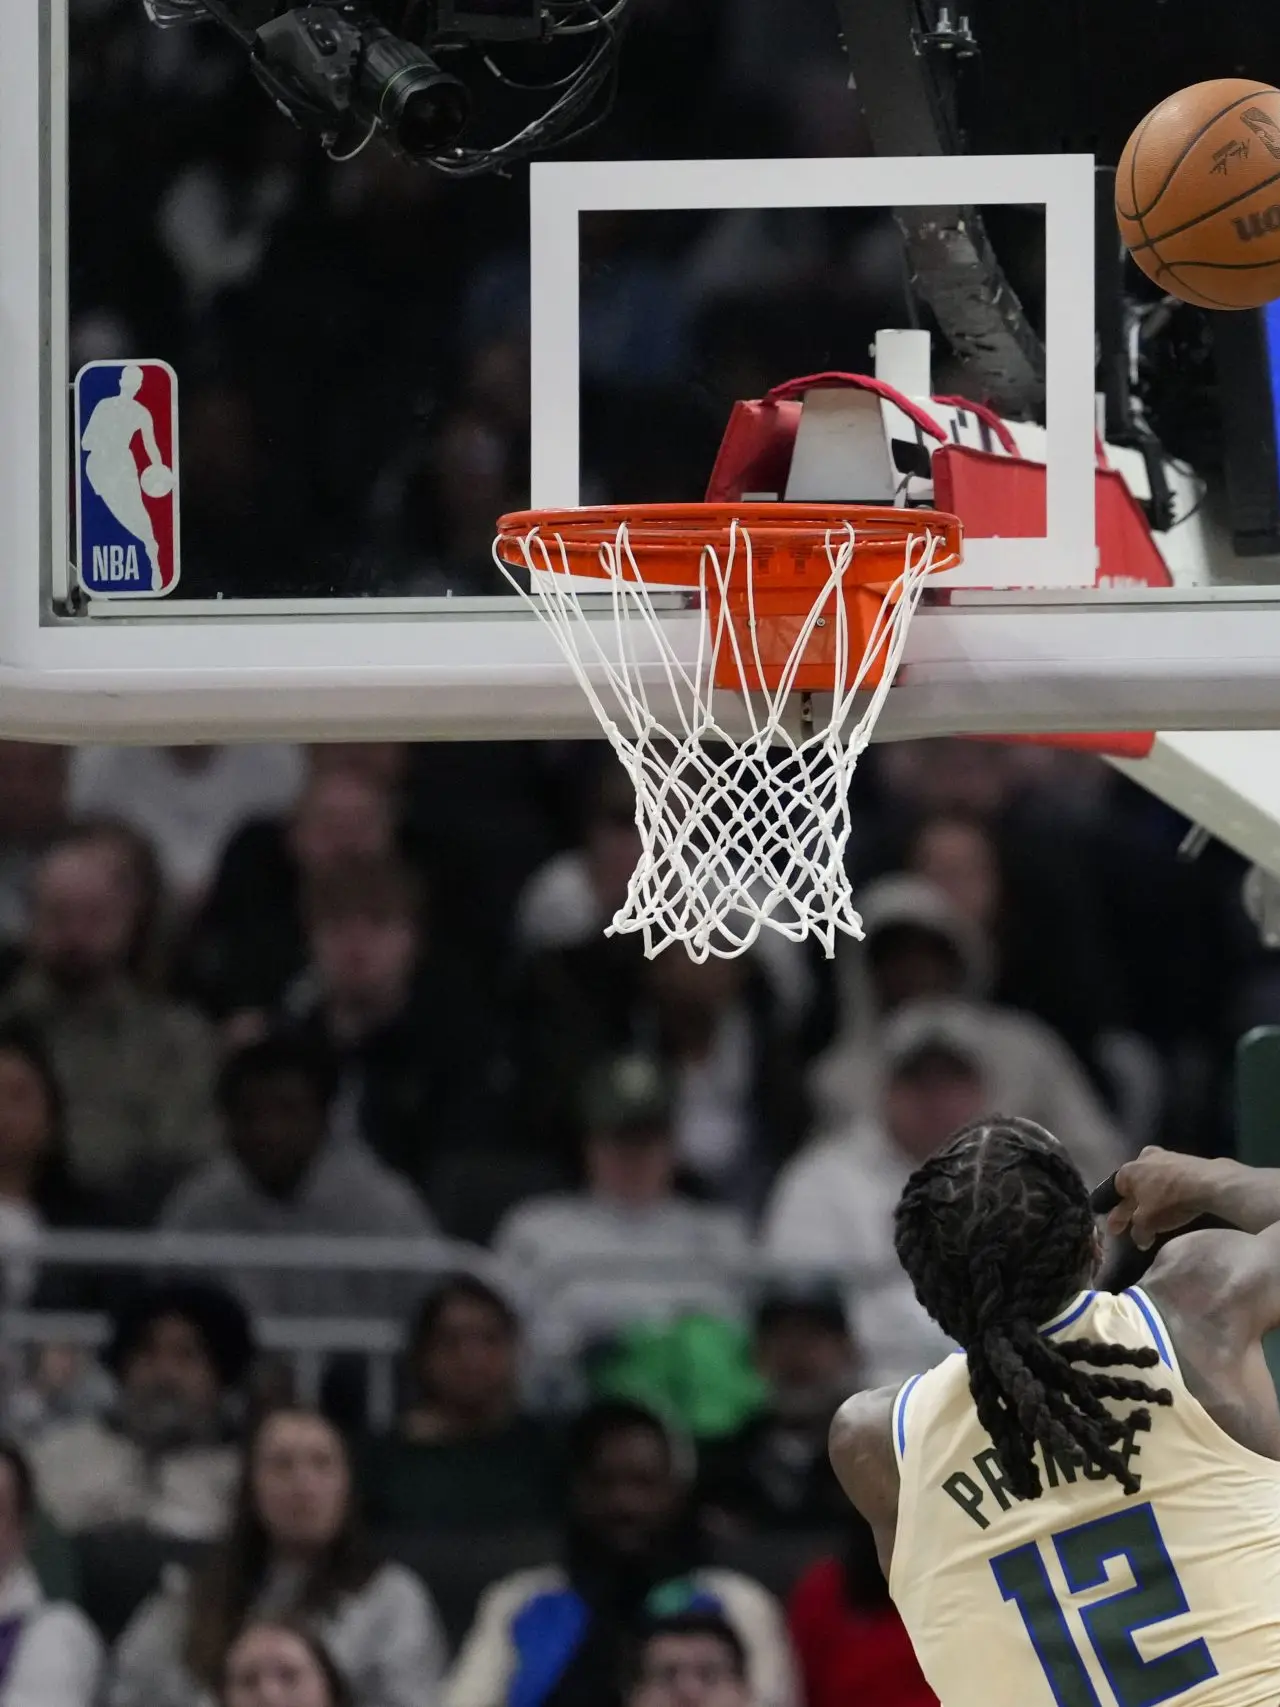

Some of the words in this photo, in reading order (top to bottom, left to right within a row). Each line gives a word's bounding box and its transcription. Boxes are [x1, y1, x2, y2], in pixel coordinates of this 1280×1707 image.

[92, 544, 140, 582] NBA
[941, 1426, 1152, 1530] PRNE
[988, 1501, 1219, 1707] 12
